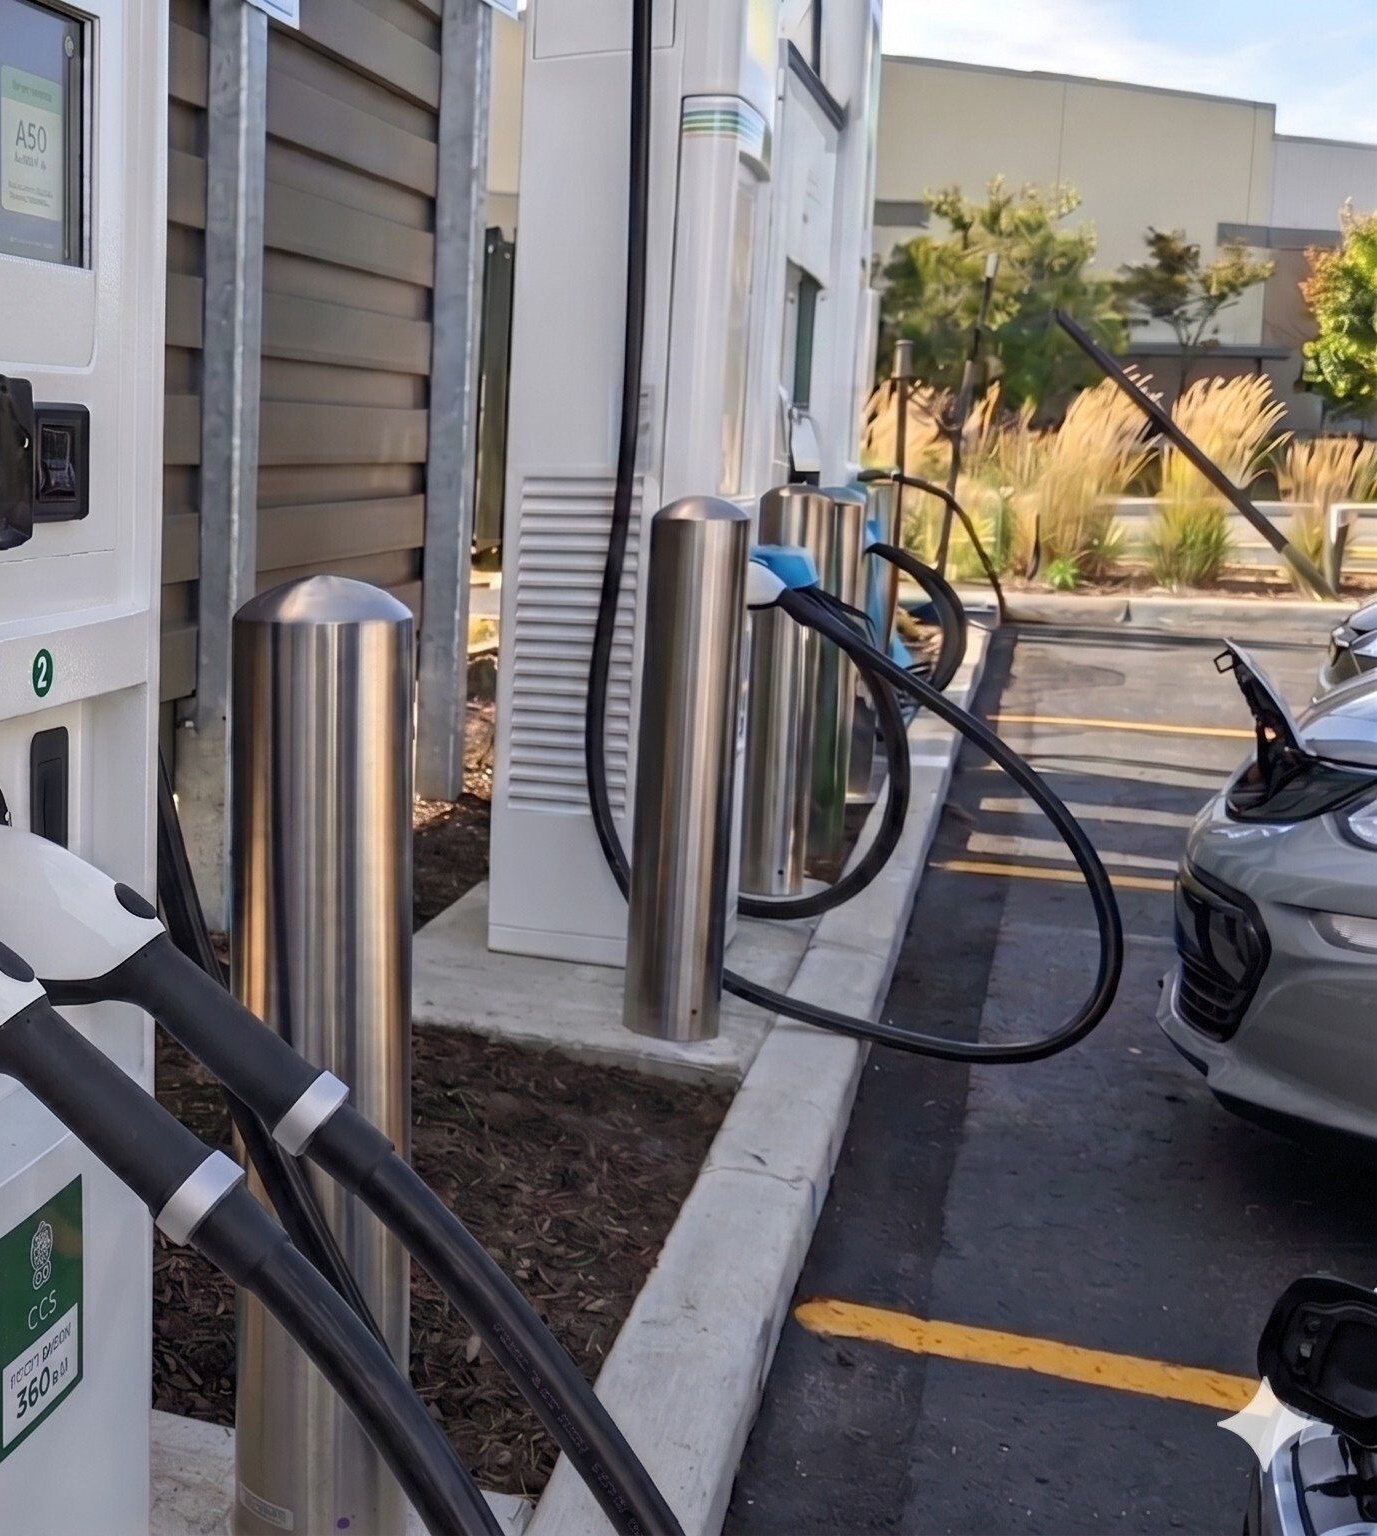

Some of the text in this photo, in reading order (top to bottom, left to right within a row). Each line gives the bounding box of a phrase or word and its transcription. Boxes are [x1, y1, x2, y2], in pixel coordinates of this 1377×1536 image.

[15, 119, 48, 155] A50
[36, 655, 48, 689] 2
[27, 1289, 57, 1330] CCS
[16, 1366, 51, 1419] 360
